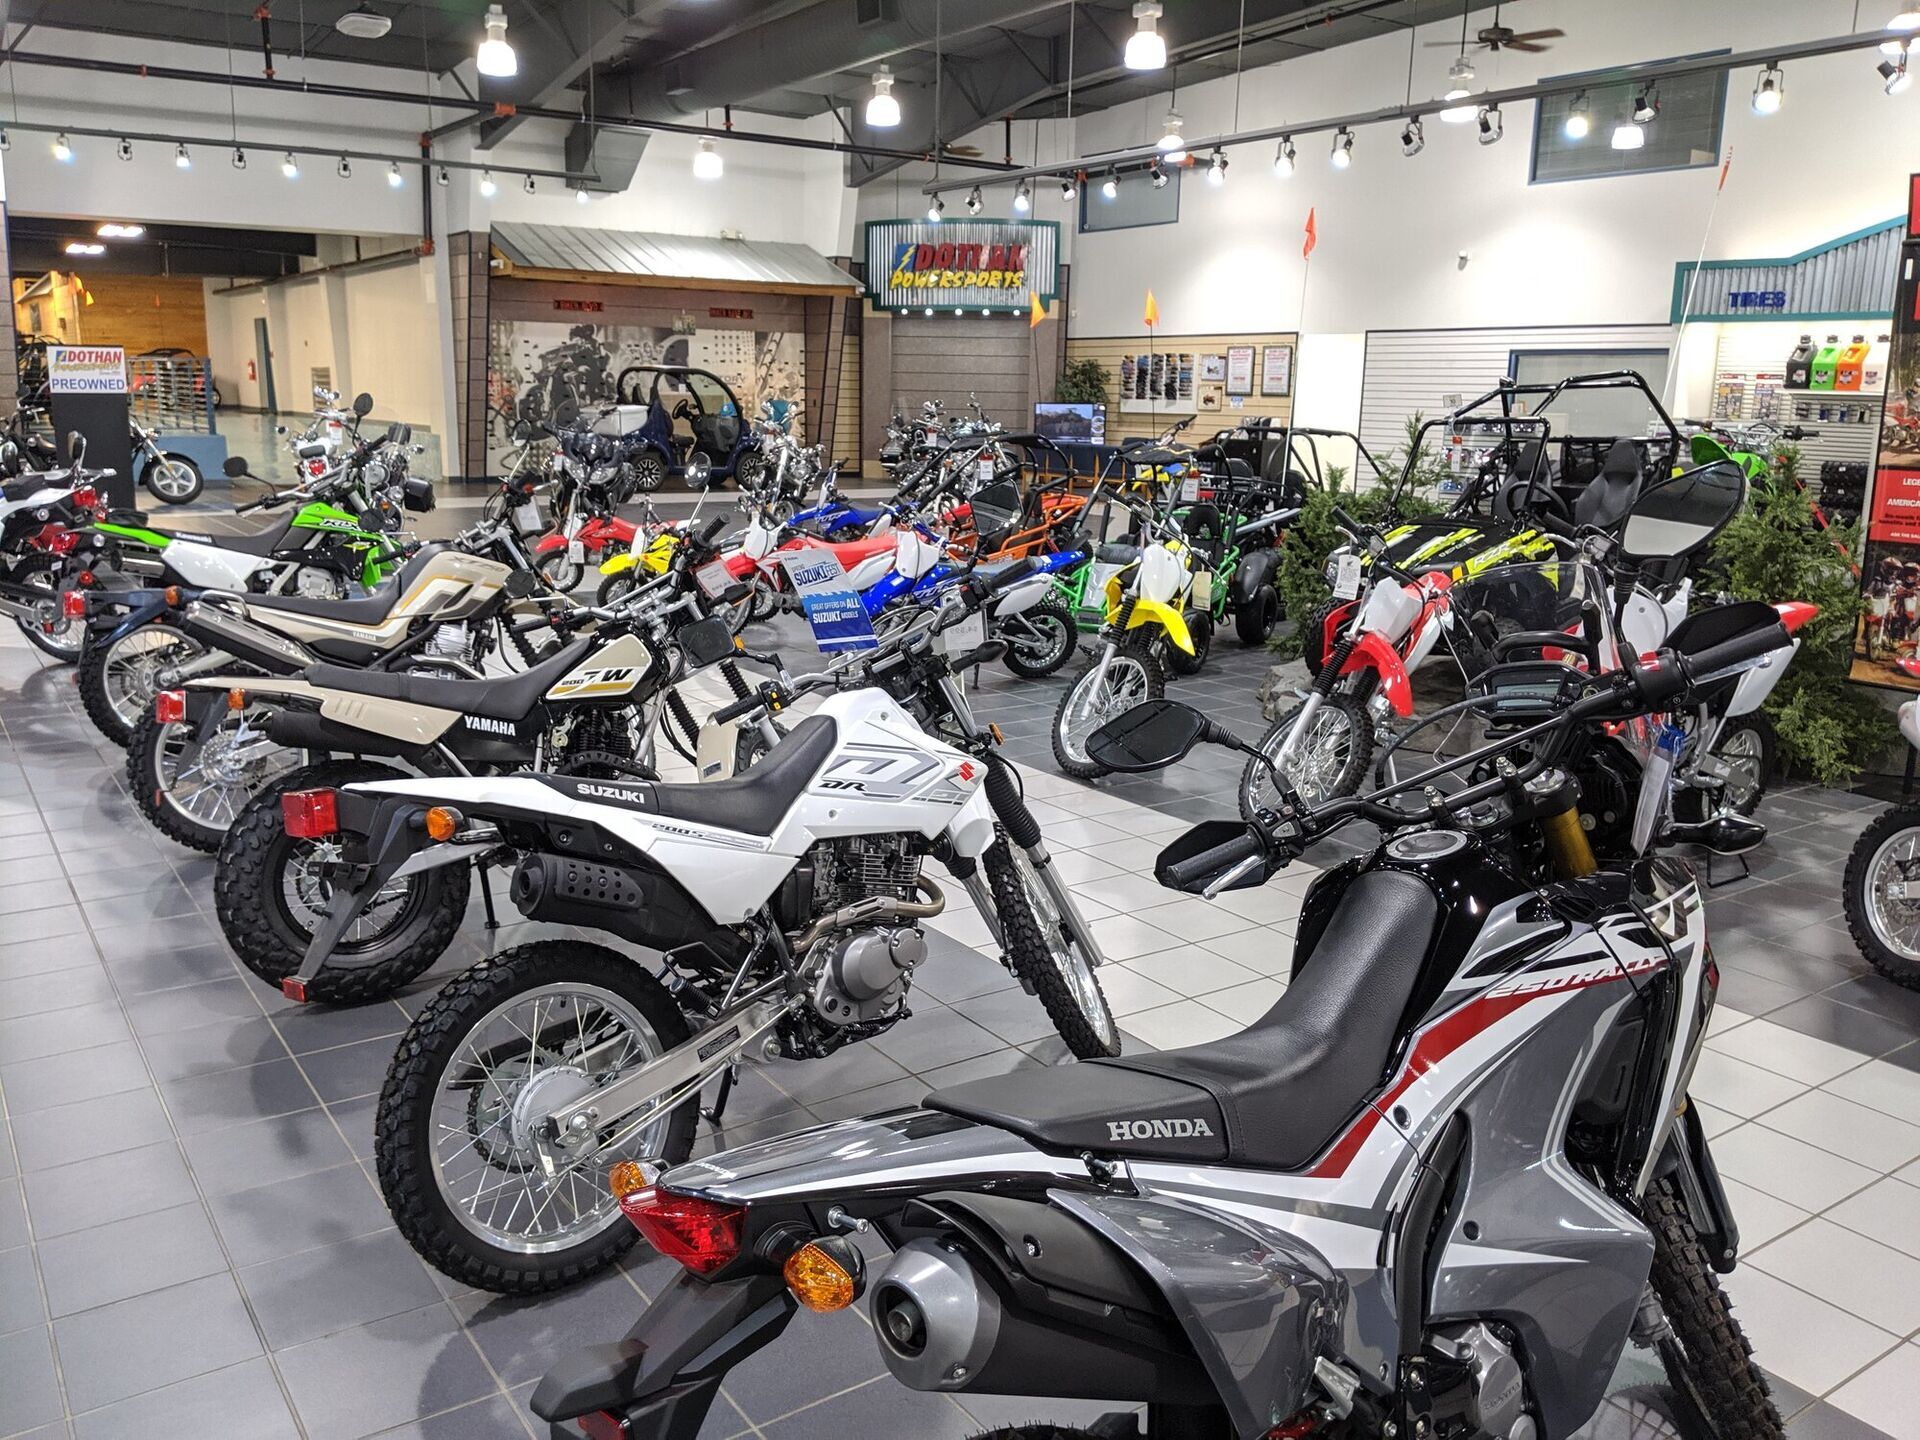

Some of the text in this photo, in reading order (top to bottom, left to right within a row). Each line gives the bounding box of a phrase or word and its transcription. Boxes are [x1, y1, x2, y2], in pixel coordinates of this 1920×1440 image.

[914, 243, 1028, 271] DOTHAN
[890, 270, 1024, 289] POWERSPORTS
[1728, 291, 1786, 308] TIRES
[67, 351, 122, 363] DOTHAN
[52, 378, 125, 390] PREOWNED
[811, 603, 824, 611] GREAT
[824, 601, 840, 609] OFFERS
[846, 598, 860, 609] ALL
[813, 610, 858, 624] SUZUKI MODELS
[352, 630, 377, 642] YAMAHA
[463, 715, 517, 737] YAMAHA
[576, 783, 645, 804] SUZUKI
[818, 780, 868, 792] DR
[1106, 1118, 1215, 1141] HONDA
